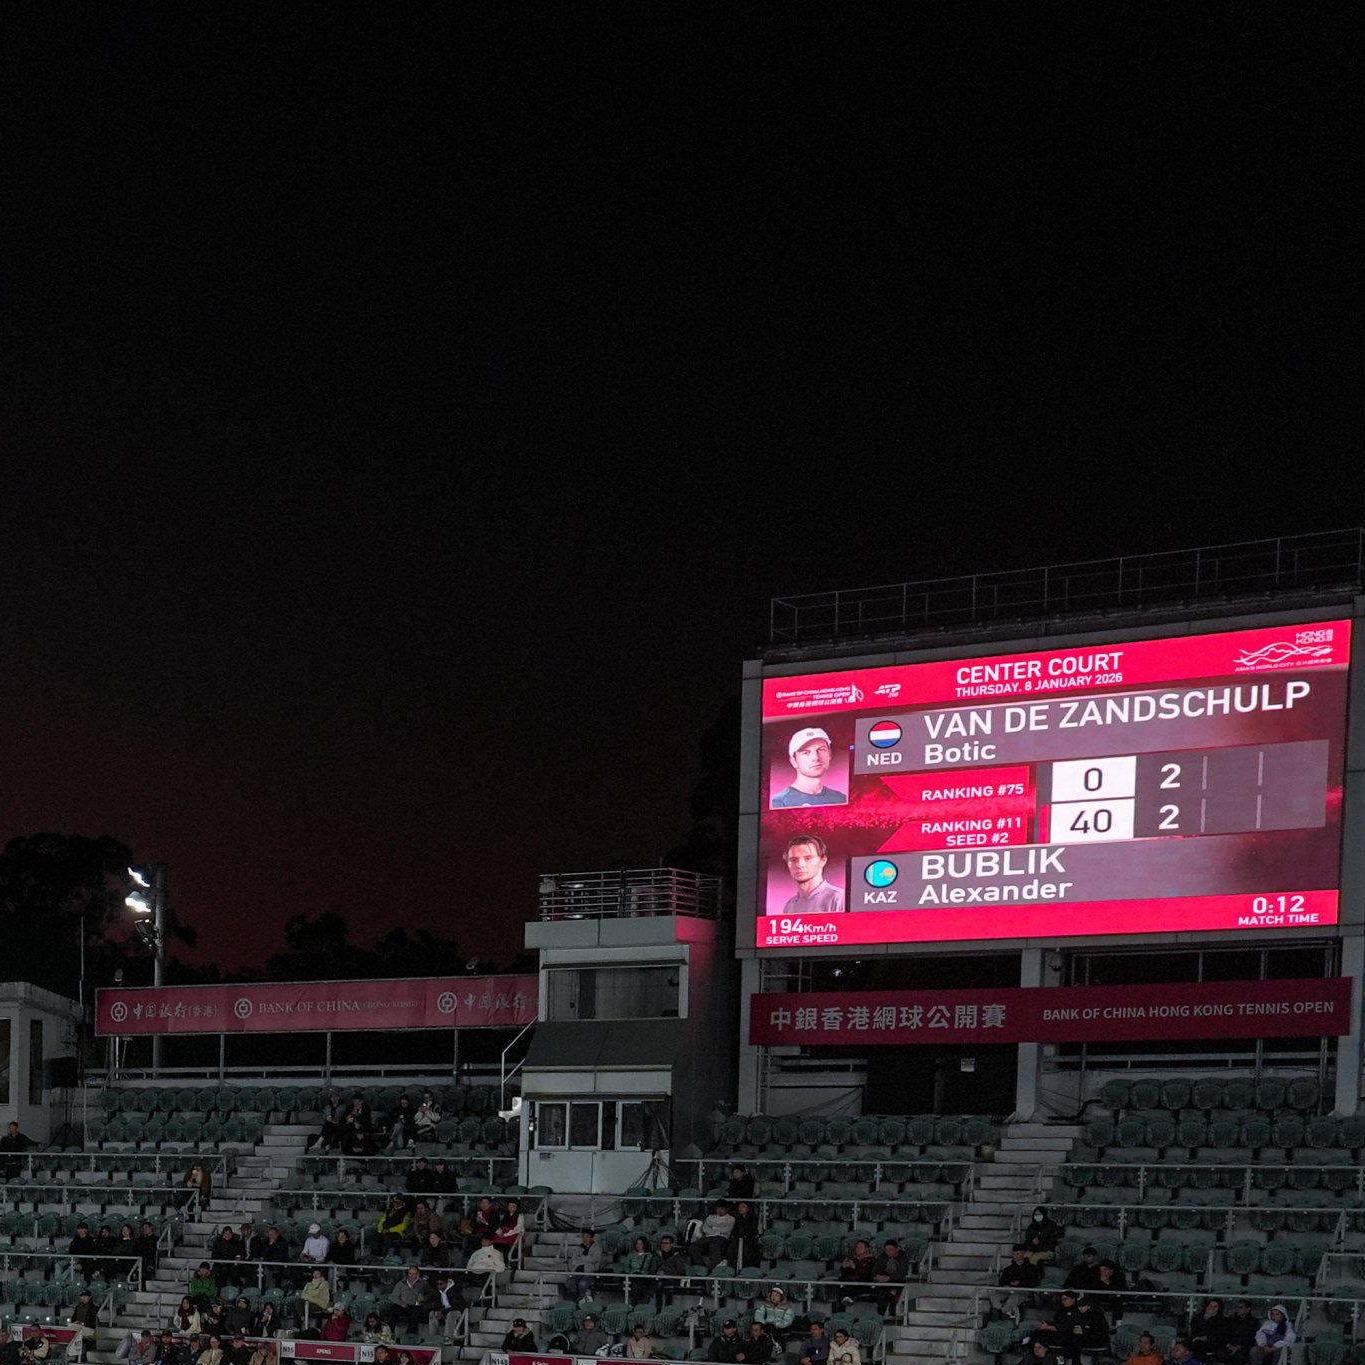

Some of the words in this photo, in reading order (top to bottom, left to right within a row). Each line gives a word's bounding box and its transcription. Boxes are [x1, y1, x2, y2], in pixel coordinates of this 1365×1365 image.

[956, 660, 1041, 685] CENTER
[1048, 651, 1123, 676] COURT
[1024, 680, 1032, 691] 8
[1034, 675, 1092, 691] JANUARY
[1094, 672, 1123, 685] 2026
[923, 709, 992, 739] VAN
[1005, 705, 1050, 733] DE
[1059, 681, 1311, 729] ZANDSCHULP
[867, 752, 902, 766] NED
[924, 741, 997, 764] Botic
[1083, 768, 1103, 792] 0
[1159, 764, 1181, 789] 2
[922, 786, 993, 801] RANKING
[997, 784, 1024, 797] #75
[921, 819, 993, 834] RANKING
[996, 817, 1021, 829] #11
[1069, 809, 1112, 834] 40
[1158, 805, 1181, 831] 2
[946, 833, 986, 847] SEED
[991, 832, 1009, 844] #2
[921, 847, 1066, 880] BUBLIK
[863, 891, 898, 904] KAZ
[918, 879, 1073, 905] Alexander
[1252, 895, 1305, 915] 0:12
[1238, 915, 1284, 926] MATCH
[1287, 913, 1319, 923] TIME
[765, 934, 799, 945] SERVE
[802, 933, 838, 944] SPEED
[770, 1003, 1006, 1031] 中銀香港網球公開賽
[1043, 1008, 1079, 1021] BANK
[1082, 1008, 1100, 1020] OF
[1103, 1006, 1146, 1020] CHINA
[1148, 1005, 1189, 1018] HONG
[1193, 1004, 1234, 1016] KONG
[1237, 1002, 1290, 1015] TENNIS
[1293, 1001, 1335, 1014] OPEN
